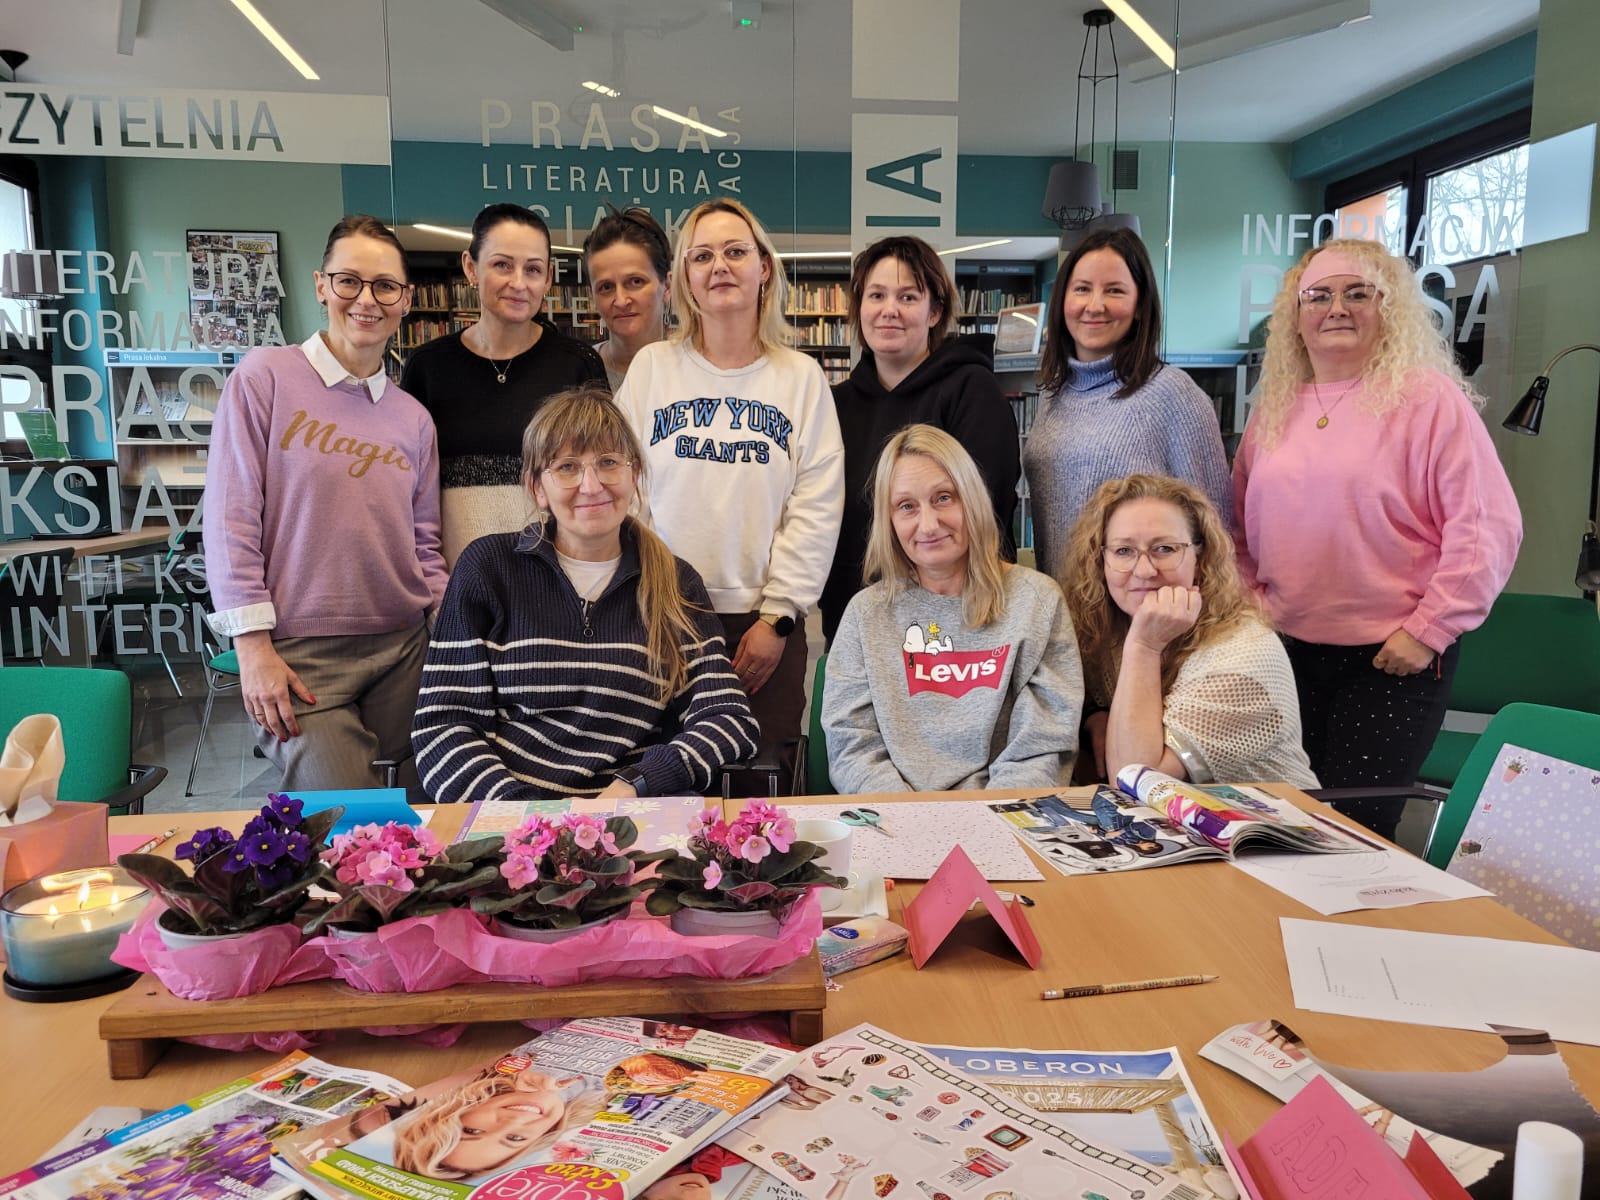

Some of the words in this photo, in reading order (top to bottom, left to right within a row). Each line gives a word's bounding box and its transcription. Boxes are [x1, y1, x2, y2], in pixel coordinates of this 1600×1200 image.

[0, 92, 284, 152] ZYTELNIA
[481, 99, 711, 154] PRASA
[482, 163, 711, 195] LITERATURA
[9, 248, 286, 297] ITERATURA
[0, 307, 287, 352] NFORMACJA
[1238, 264, 1500, 343] PSA
[0, 366, 226, 442] PRAS
[651, 397, 721, 447] NEW
[725, 396, 793, 451] YORK
[280, 409, 412, 478] Magic
[675, 434, 770, 464] GIANTS
[0, 462, 207, 550] KSIĄ
[10, 602, 233, 658] INTERN
[718, 1077, 760, 1096] 35
[335, 1160, 372, 1178] PORAD
[543, 1163, 630, 1191] Extra
